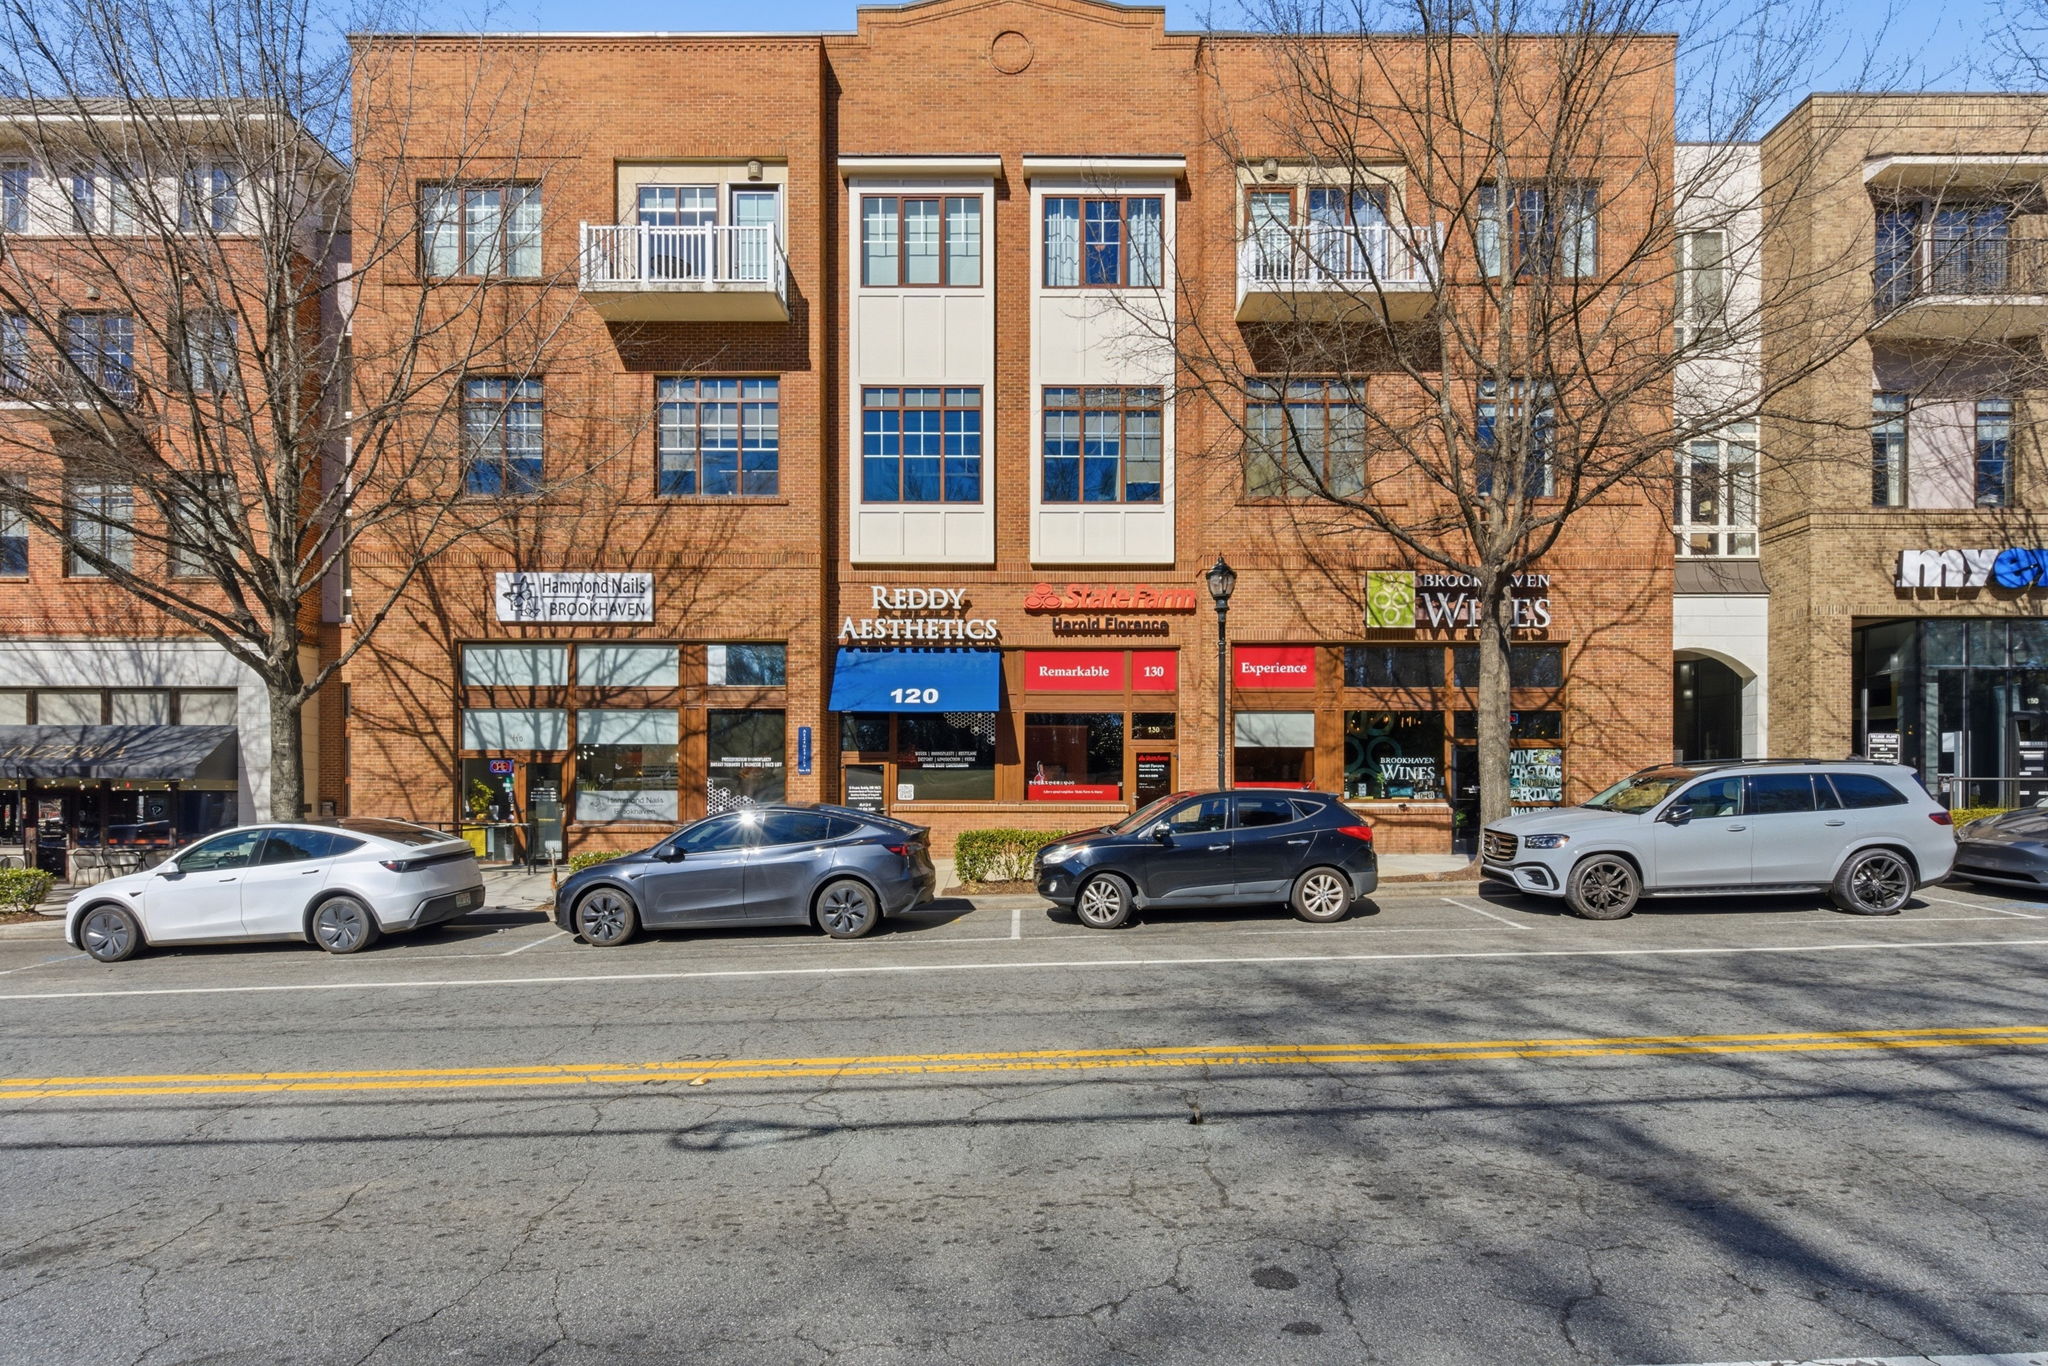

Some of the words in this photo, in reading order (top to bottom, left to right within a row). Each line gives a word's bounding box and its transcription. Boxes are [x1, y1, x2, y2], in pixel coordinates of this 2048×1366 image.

[542, 578, 608, 594] Hammond
[611, 578, 646, 594] Nails
[1423, 574, 1551, 587] BROOKVEN
[870, 585, 967, 610] REDDY
[550, 602, 646, 616] BROOKHAVEN
[1419, 592, 1551, 628] WIES
[837, 616, 998, 640] AESTHETICS
[1052, 617, 1100, 632] Harold
[1105, 617, 1170, 632] Florence
[1038, 665, 1110, 678] Remarkable
[1143, 665, 1165, 678] 130
[1240, 661, 1308, 675] Experience
[890, 688, 940, 704] 120
[1147, 726, 1161, 734] 130
[1380, 764, 1436, 780] WINES
